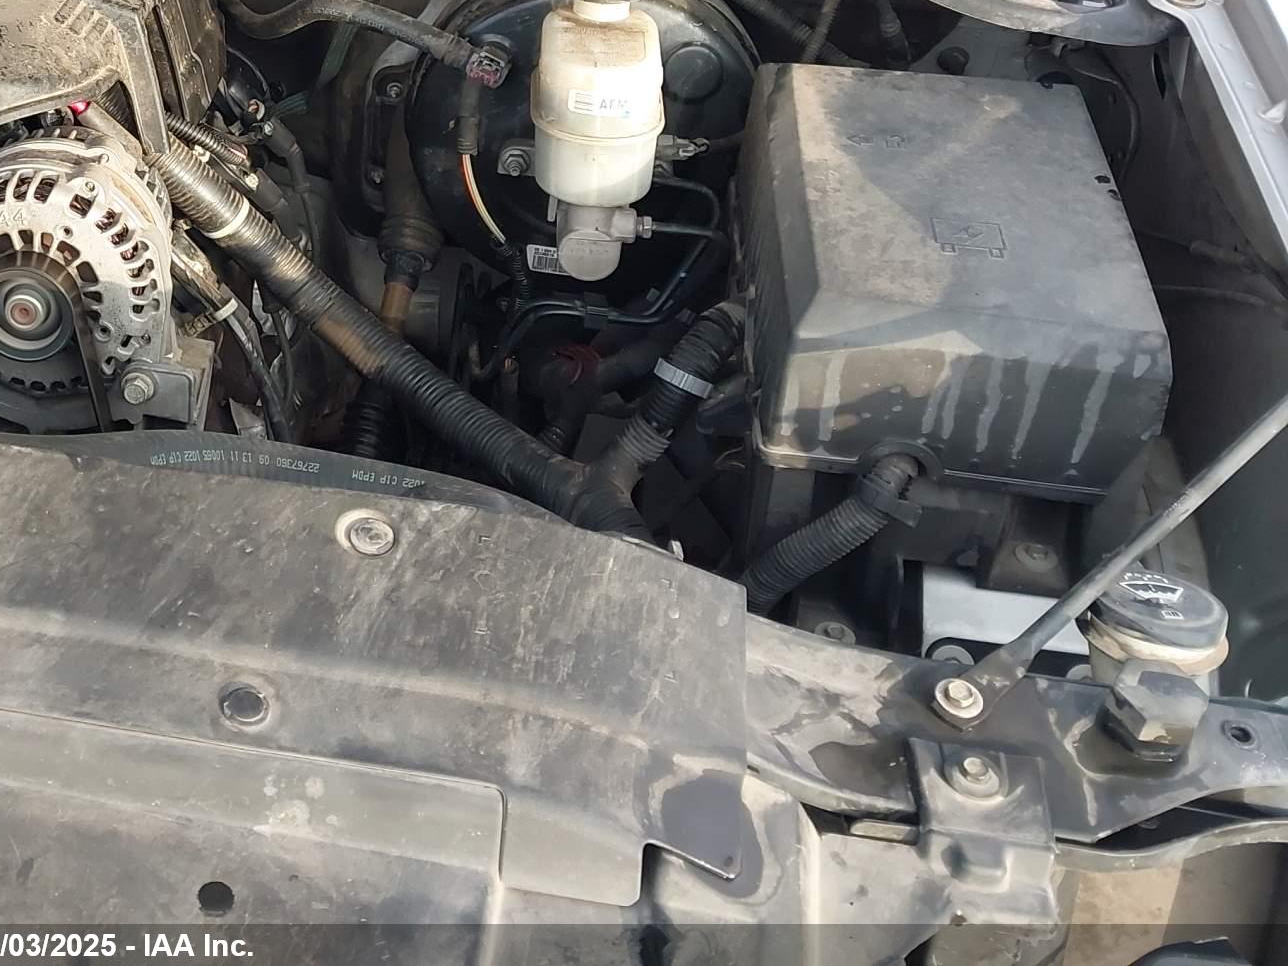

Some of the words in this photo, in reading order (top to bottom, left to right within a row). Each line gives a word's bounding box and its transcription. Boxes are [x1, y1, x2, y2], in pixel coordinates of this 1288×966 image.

[242, 452, 253, 463] 13
[258, 454, 270, 465] 09
[276, 458, 320, 474] 22767360
